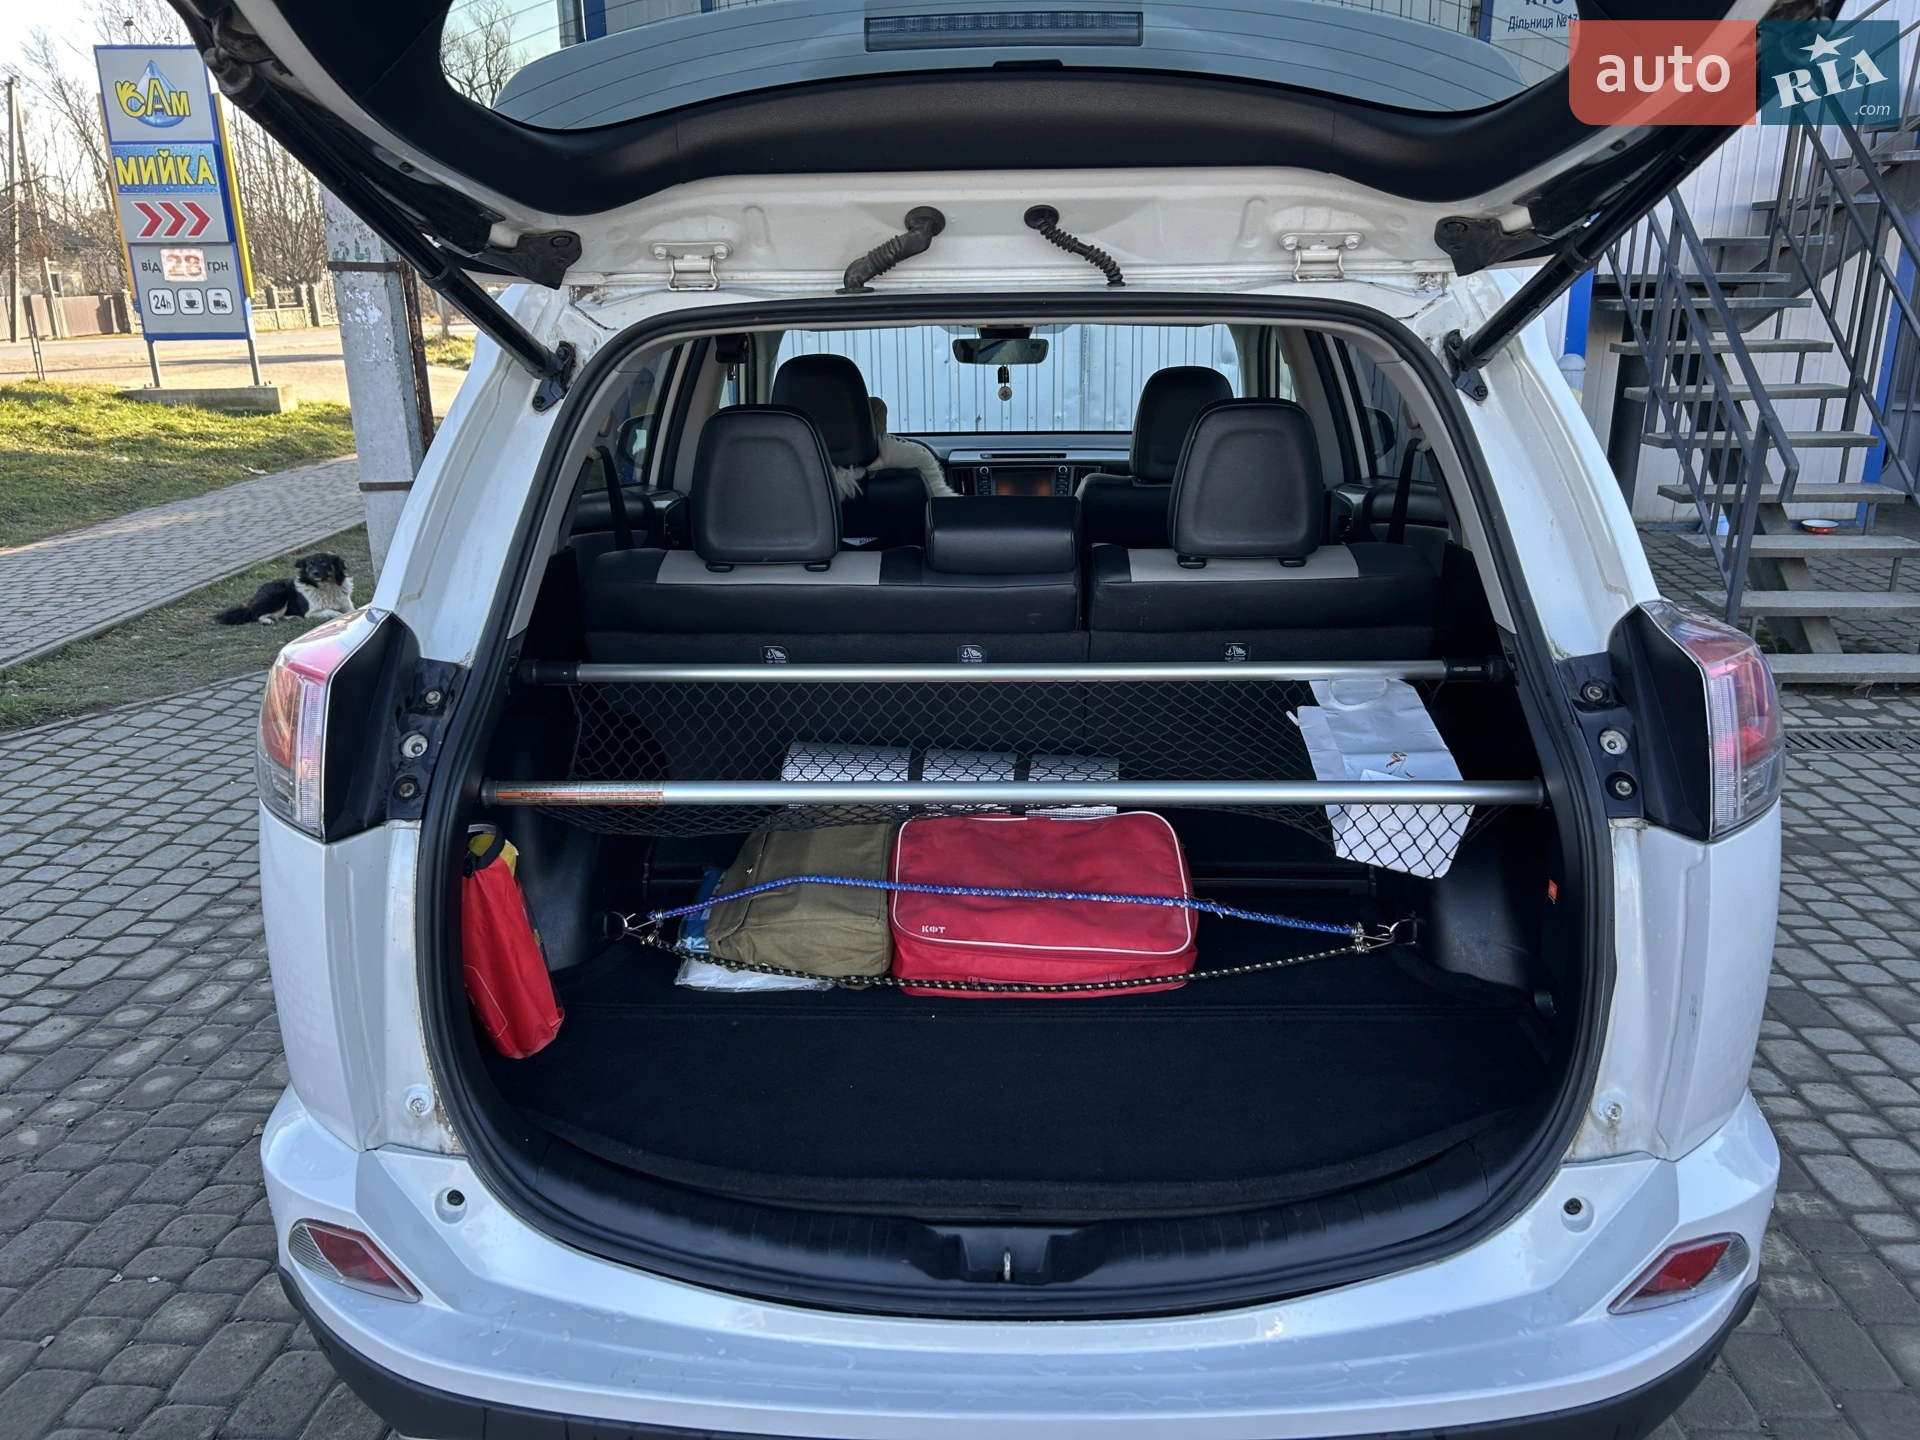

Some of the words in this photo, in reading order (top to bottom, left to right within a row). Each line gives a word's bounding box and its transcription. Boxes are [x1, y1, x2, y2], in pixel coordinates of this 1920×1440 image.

[1508, 15, 1553, 32] Дільниця
[114, 149, 216, 186] МИЙКА
[141, 259, 162, 274] від
[165, 252, 203, 277] 28
[207, 261, 229, 274] грн
[153, 294, 173, 310] 24h
